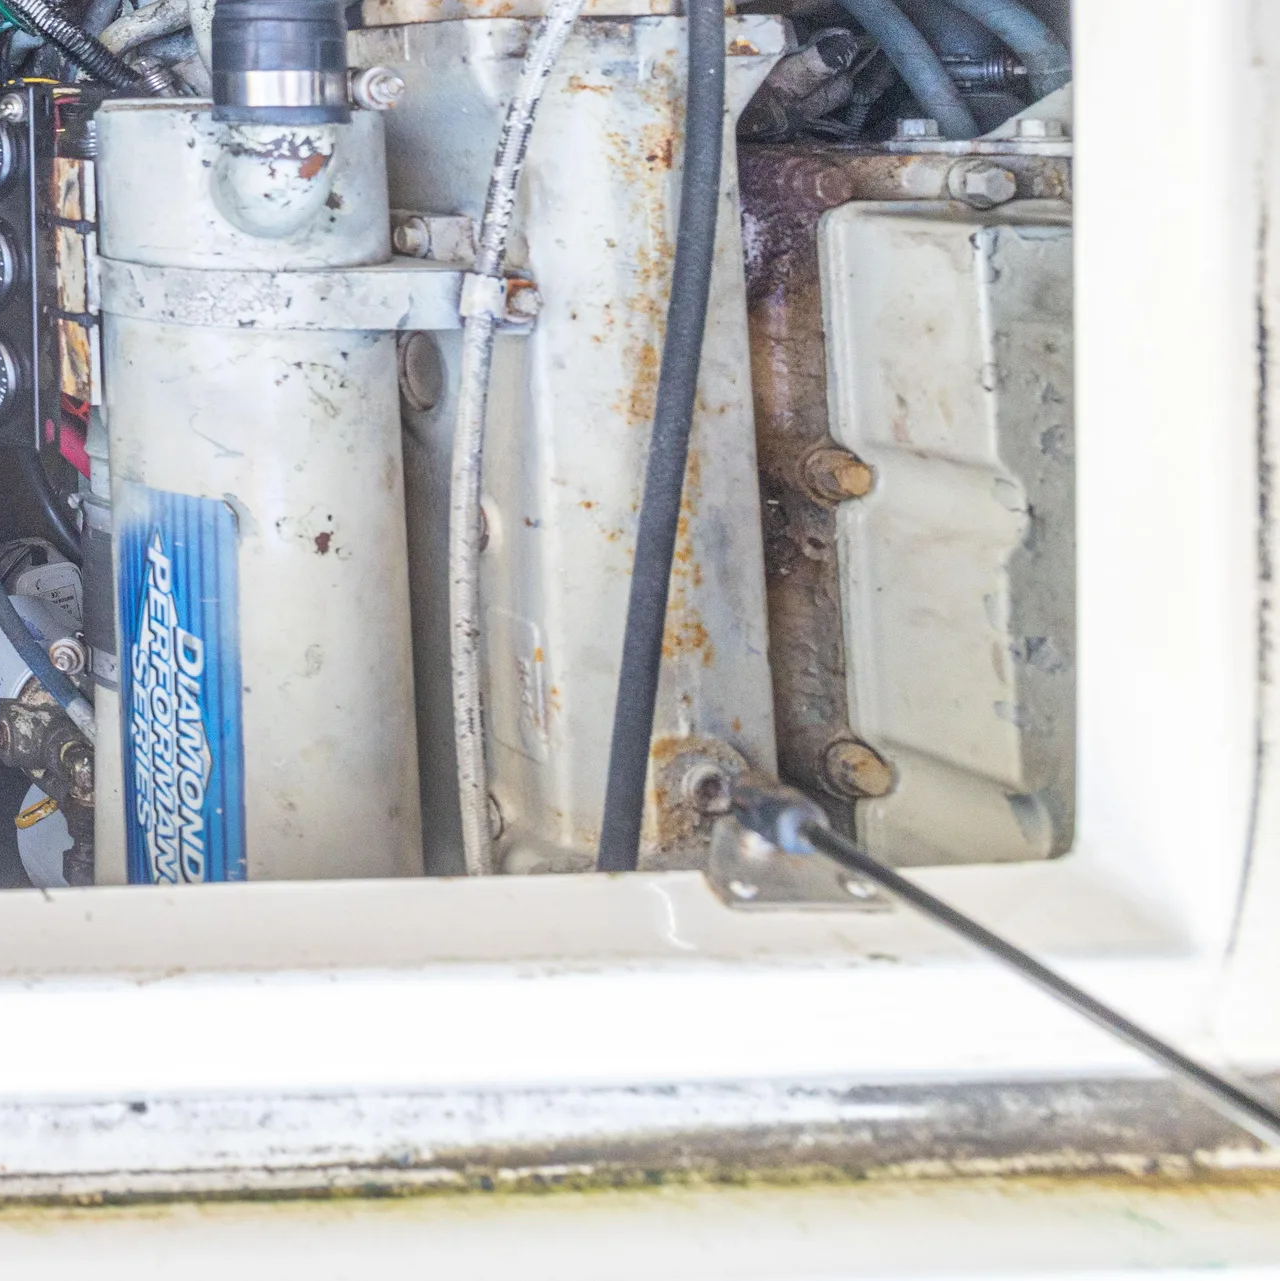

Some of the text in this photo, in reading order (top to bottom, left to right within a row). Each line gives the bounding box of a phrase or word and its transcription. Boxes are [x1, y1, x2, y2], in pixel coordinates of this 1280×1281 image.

[131, 643, 152, 833] SERIES
[147, 547, 178, 885] PERFORMAN
[174, 626, 205, 883] DIAMOND
